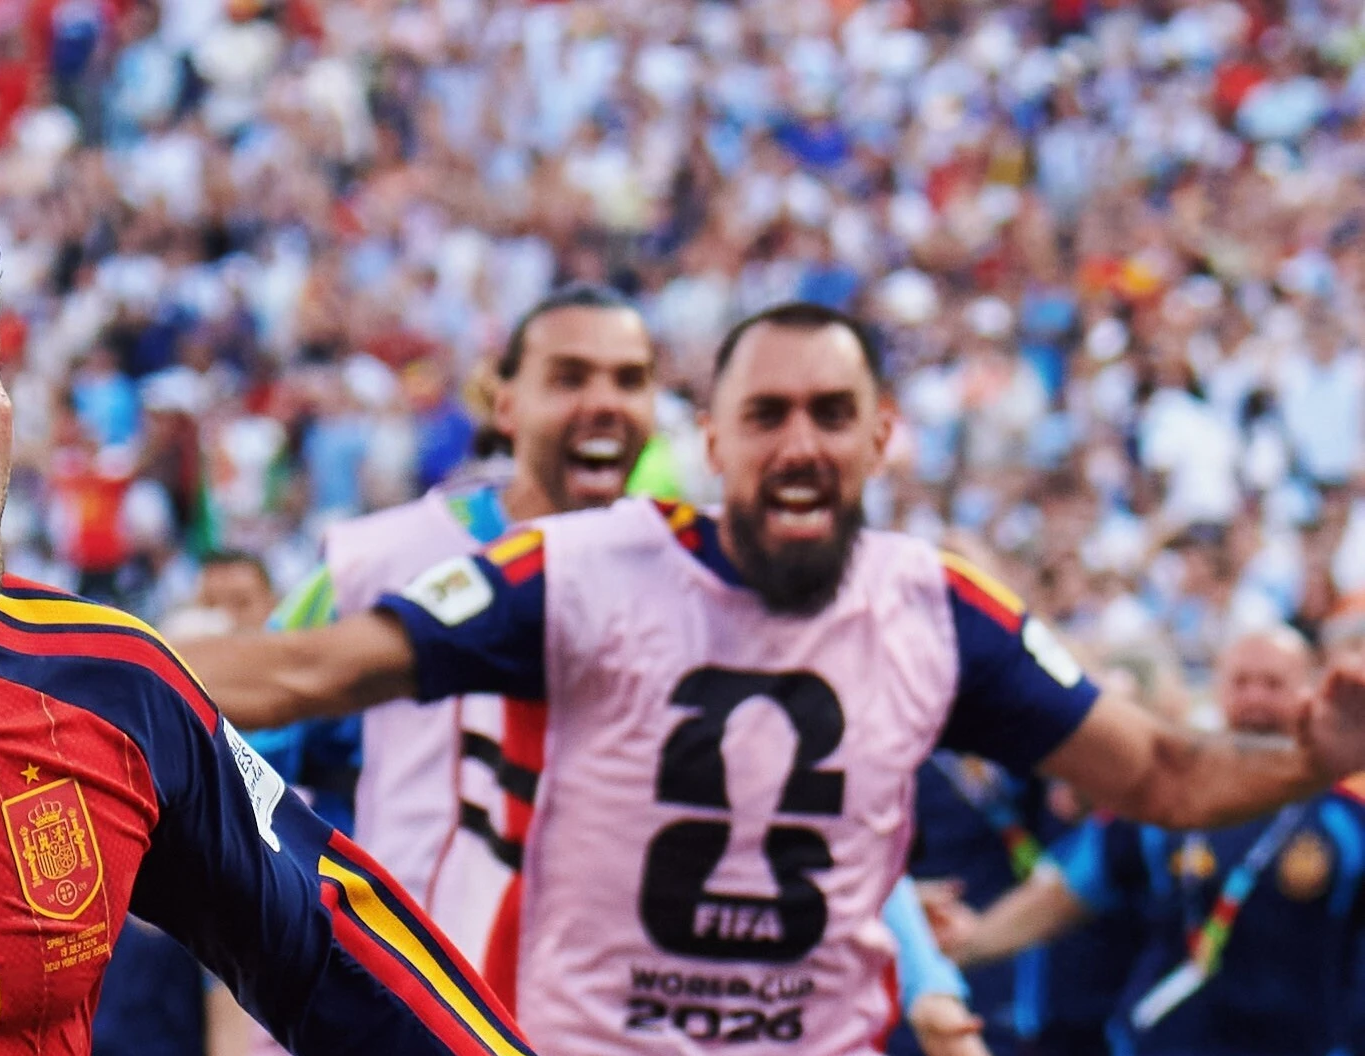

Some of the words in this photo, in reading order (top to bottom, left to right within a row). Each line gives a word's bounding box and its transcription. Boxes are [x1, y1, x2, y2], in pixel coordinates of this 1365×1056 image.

[693, 902, 783, 941] FIFA
[46, 936, 65, 949] SPAIN
[69, 942, 82, 955] JULY
[61, 955, 77, 968] YORK
[631, 967, 752, 997] WORLD
[756, 974, 815, 1004] CUP
[626, 998, 804, 1042] 2026
